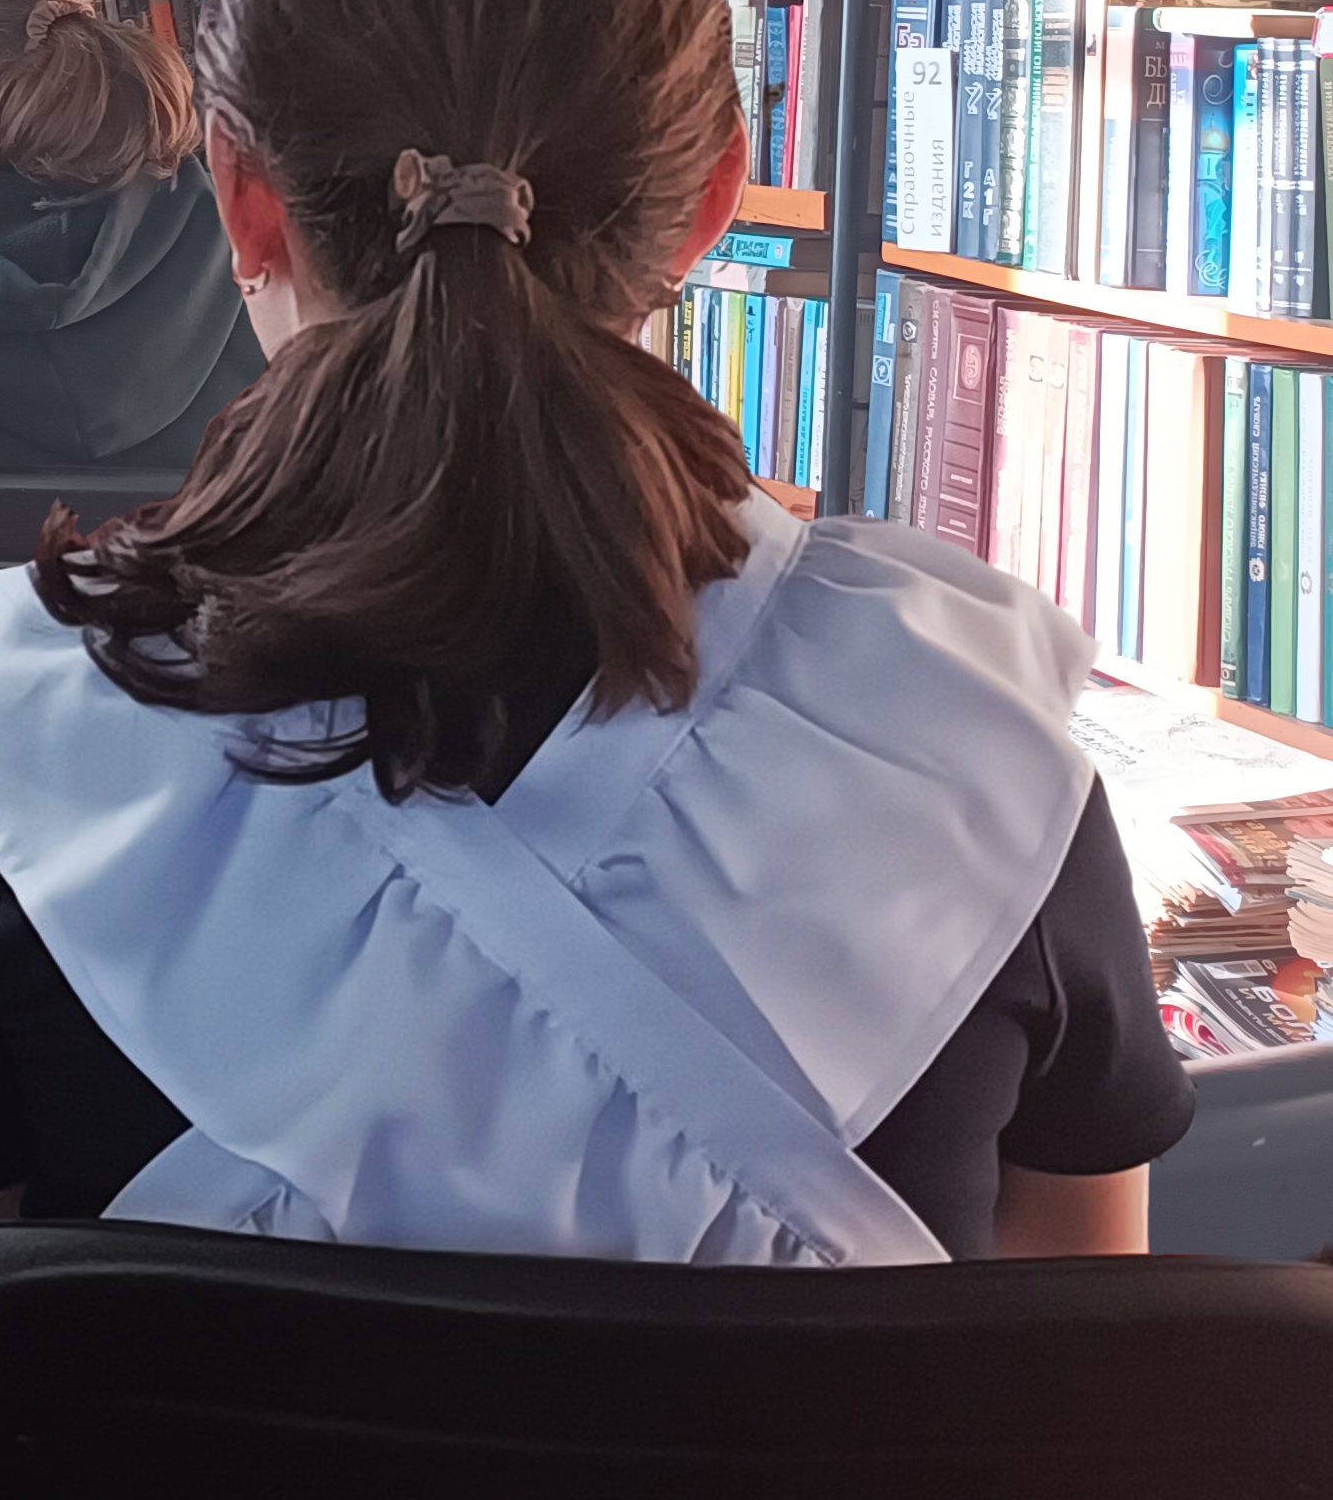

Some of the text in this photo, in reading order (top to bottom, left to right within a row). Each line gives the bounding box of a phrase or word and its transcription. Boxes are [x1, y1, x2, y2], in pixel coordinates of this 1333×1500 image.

[912, 60, 942, 85] 92
[899, 90, 916, 236] Справочные
[930, 138, 944, 238] издания
[920, 365, 940, 488] СЛОВАРЬ РУССКОГО
[1251, 395, 1261, 438] СЛОВАРЬ
[1256, 470, 1268, 549] ЮНОГО ФИЗИКА
